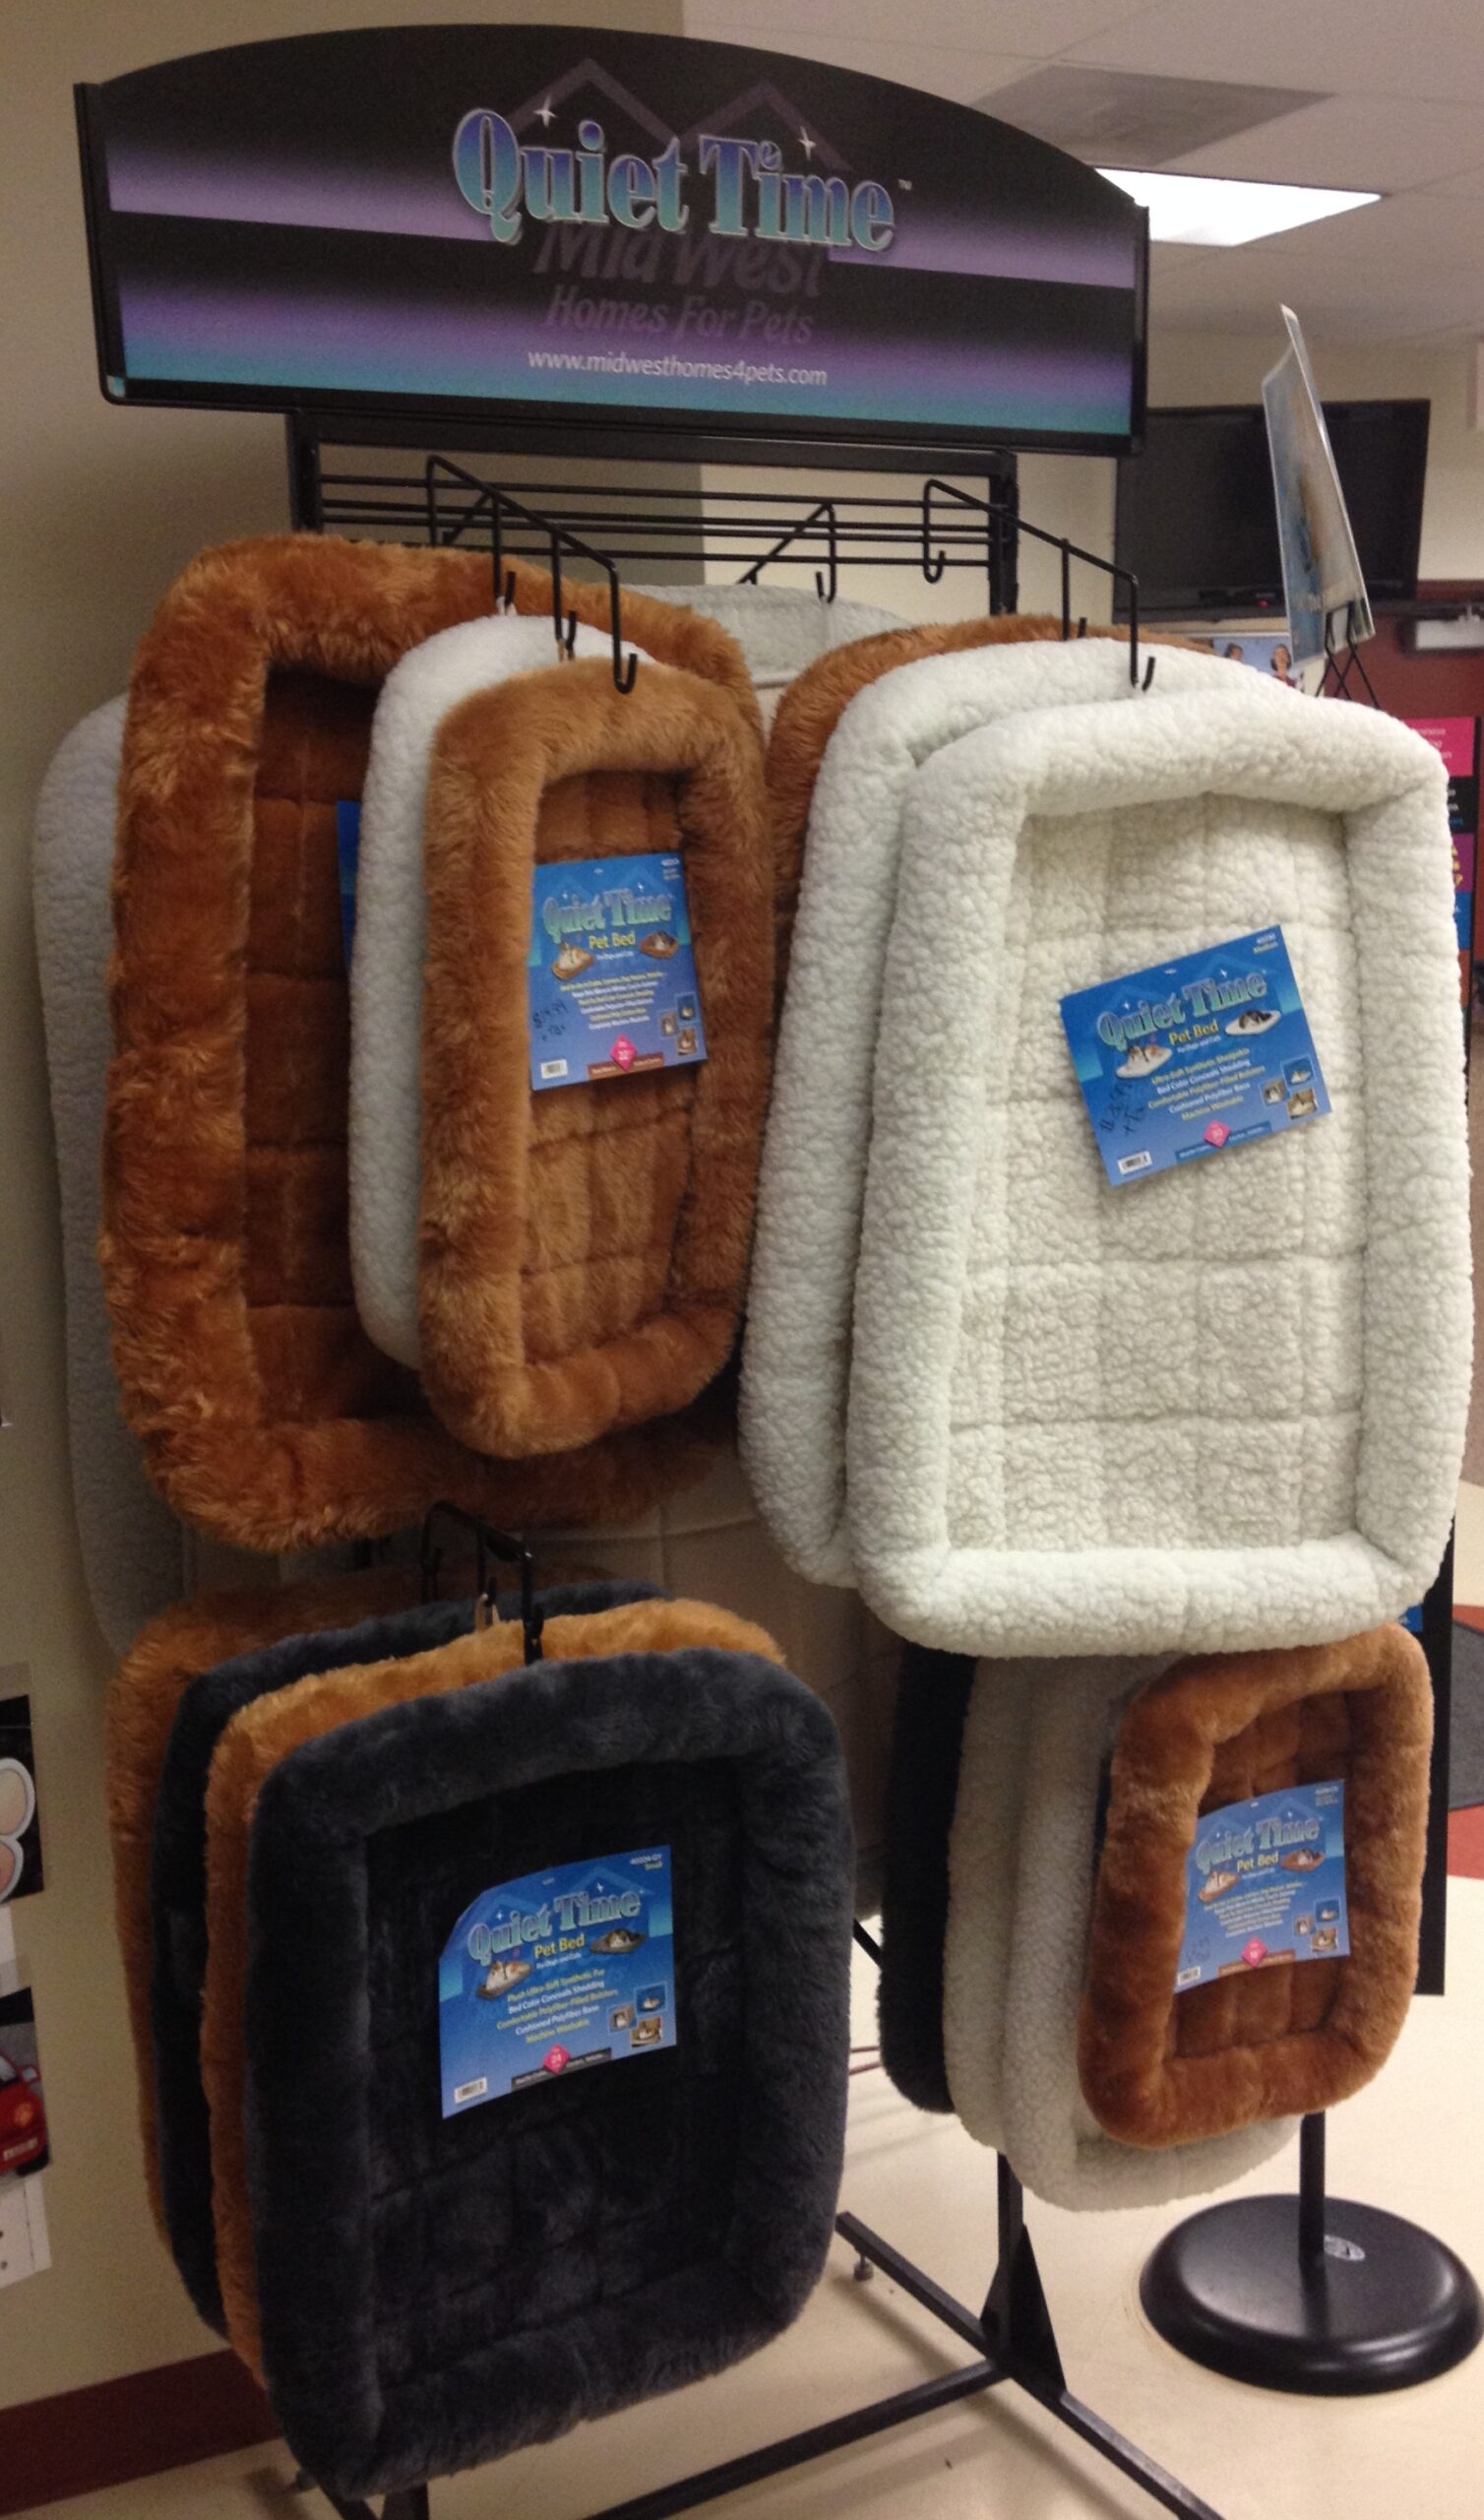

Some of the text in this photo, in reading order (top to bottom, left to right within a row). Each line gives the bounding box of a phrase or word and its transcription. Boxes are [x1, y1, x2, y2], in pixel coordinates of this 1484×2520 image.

[453, 108, 689, 244] Quiet
[700, 134, 895, 251] Time
[546, 284, 815, 346] Homes For Pets
[527, 348, 829, 385] www.midwesthomes4pets.com
[543, 888, 673, 944] Quiet Time
[588, 930, 636, 950] Pet Bed
[1096, 972, 1268, 1051] Quiet Time
[1168, 1019, 1219, 1045] Pet Bed
[1196, 1817, 1321, 1875] Quiet Time
[1237, 1858, 1254, 1873] Pet
[1258, 1851, 1278, 1867] Bed
[467, 1890, 641, 1967] Quiet Time
[534, 1932, 585, 1959] Pet Bed
[509, 1981, 605, 2014] Bed Color Conceals Shedding
[516, 2018, 551, 2036] Cushioned
[582, 2004, 600, 2014] Base
